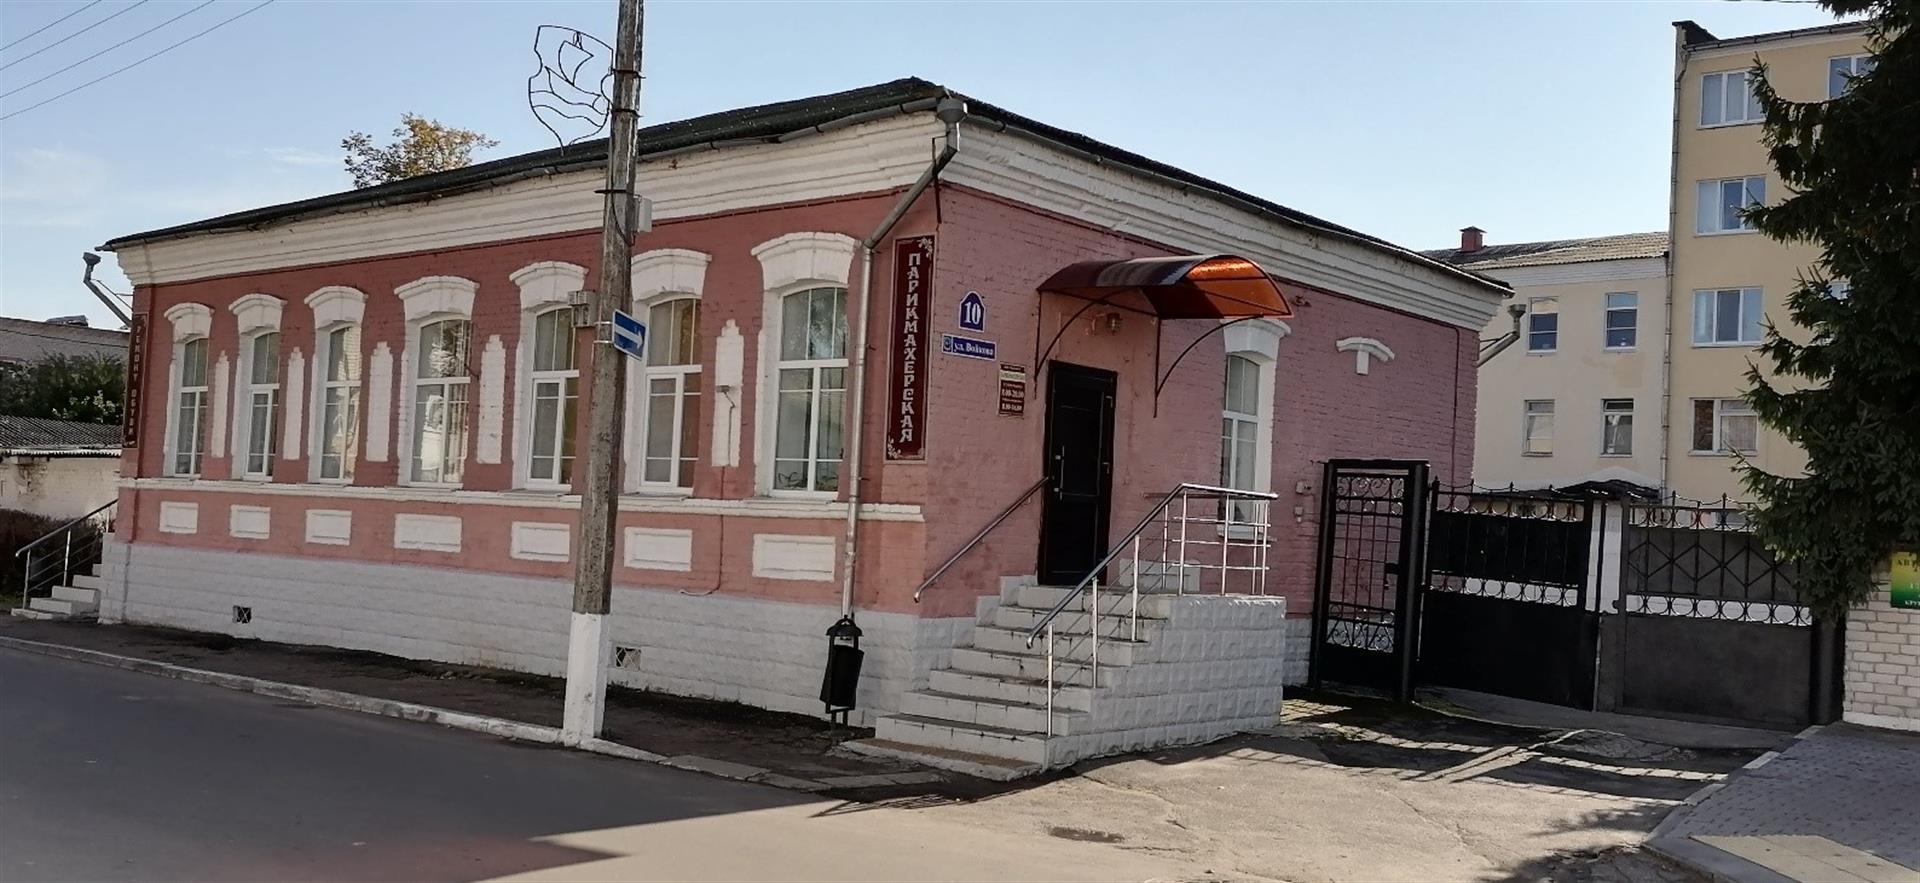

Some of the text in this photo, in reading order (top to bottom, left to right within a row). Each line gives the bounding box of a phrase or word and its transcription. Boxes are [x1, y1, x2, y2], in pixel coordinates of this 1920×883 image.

[964, 301, 982, 325] 10
[133, 326, 141, 381] РЕМОНТ
[899, 253, 921, 443] ПАРИКМАХЕРСКАЯ
[953, 342, 994, 356] ул. Войкова
